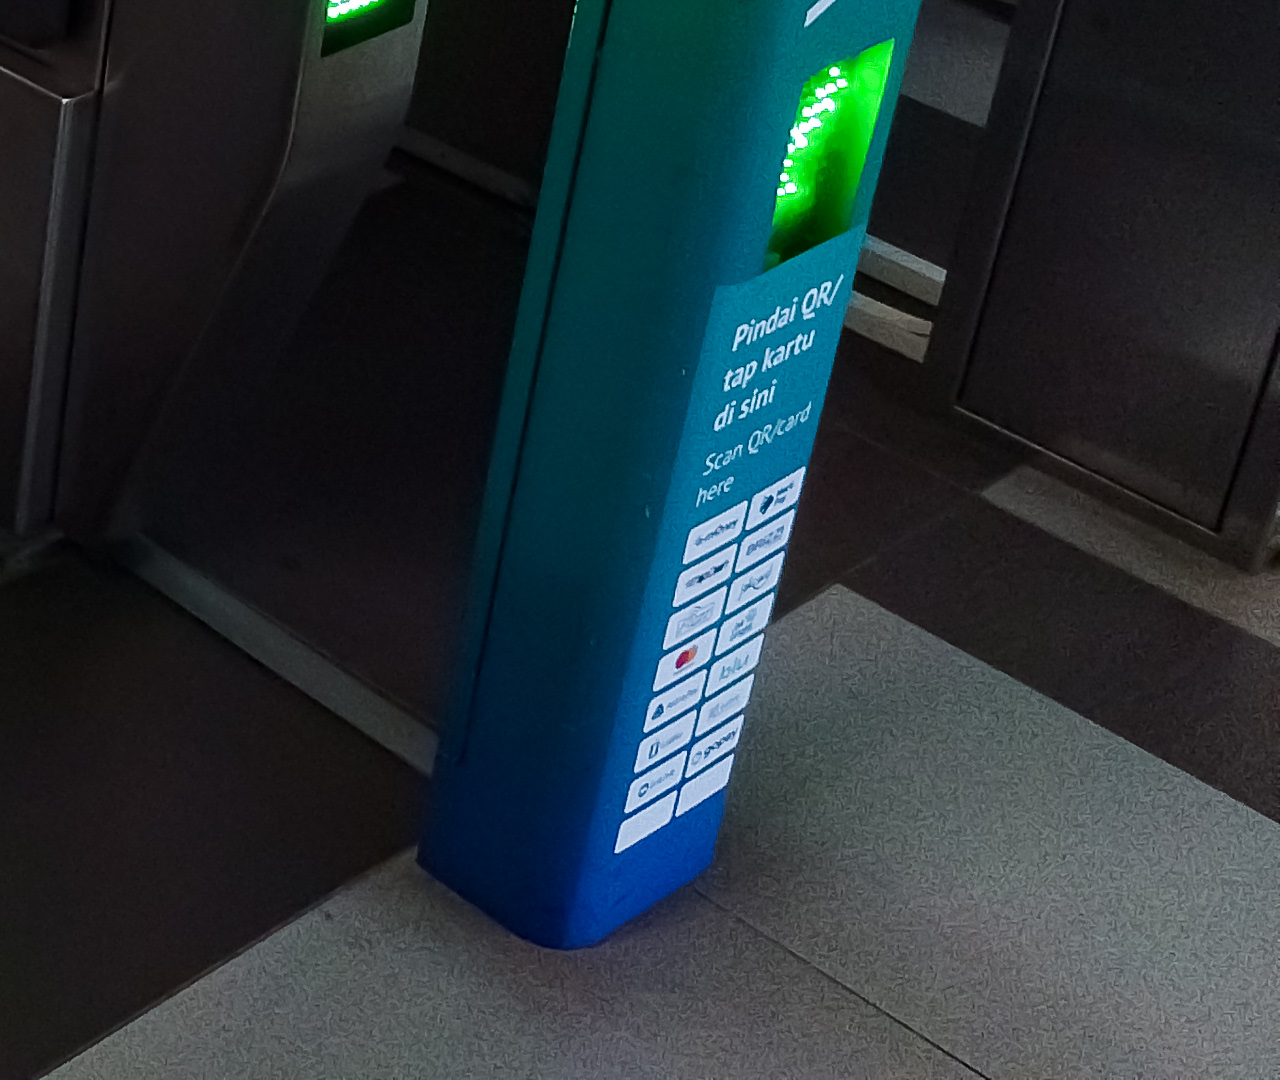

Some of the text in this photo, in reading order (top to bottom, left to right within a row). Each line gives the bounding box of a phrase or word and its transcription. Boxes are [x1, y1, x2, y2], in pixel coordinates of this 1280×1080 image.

[731, 273, 844, 352] Pindai QR/
[723, 329, 816, 393] tap kartu
[713, 379, 778, 432] di sini
[702, 400, 813, 476] Scan QR/card
[695, 476, 735, 508] here
